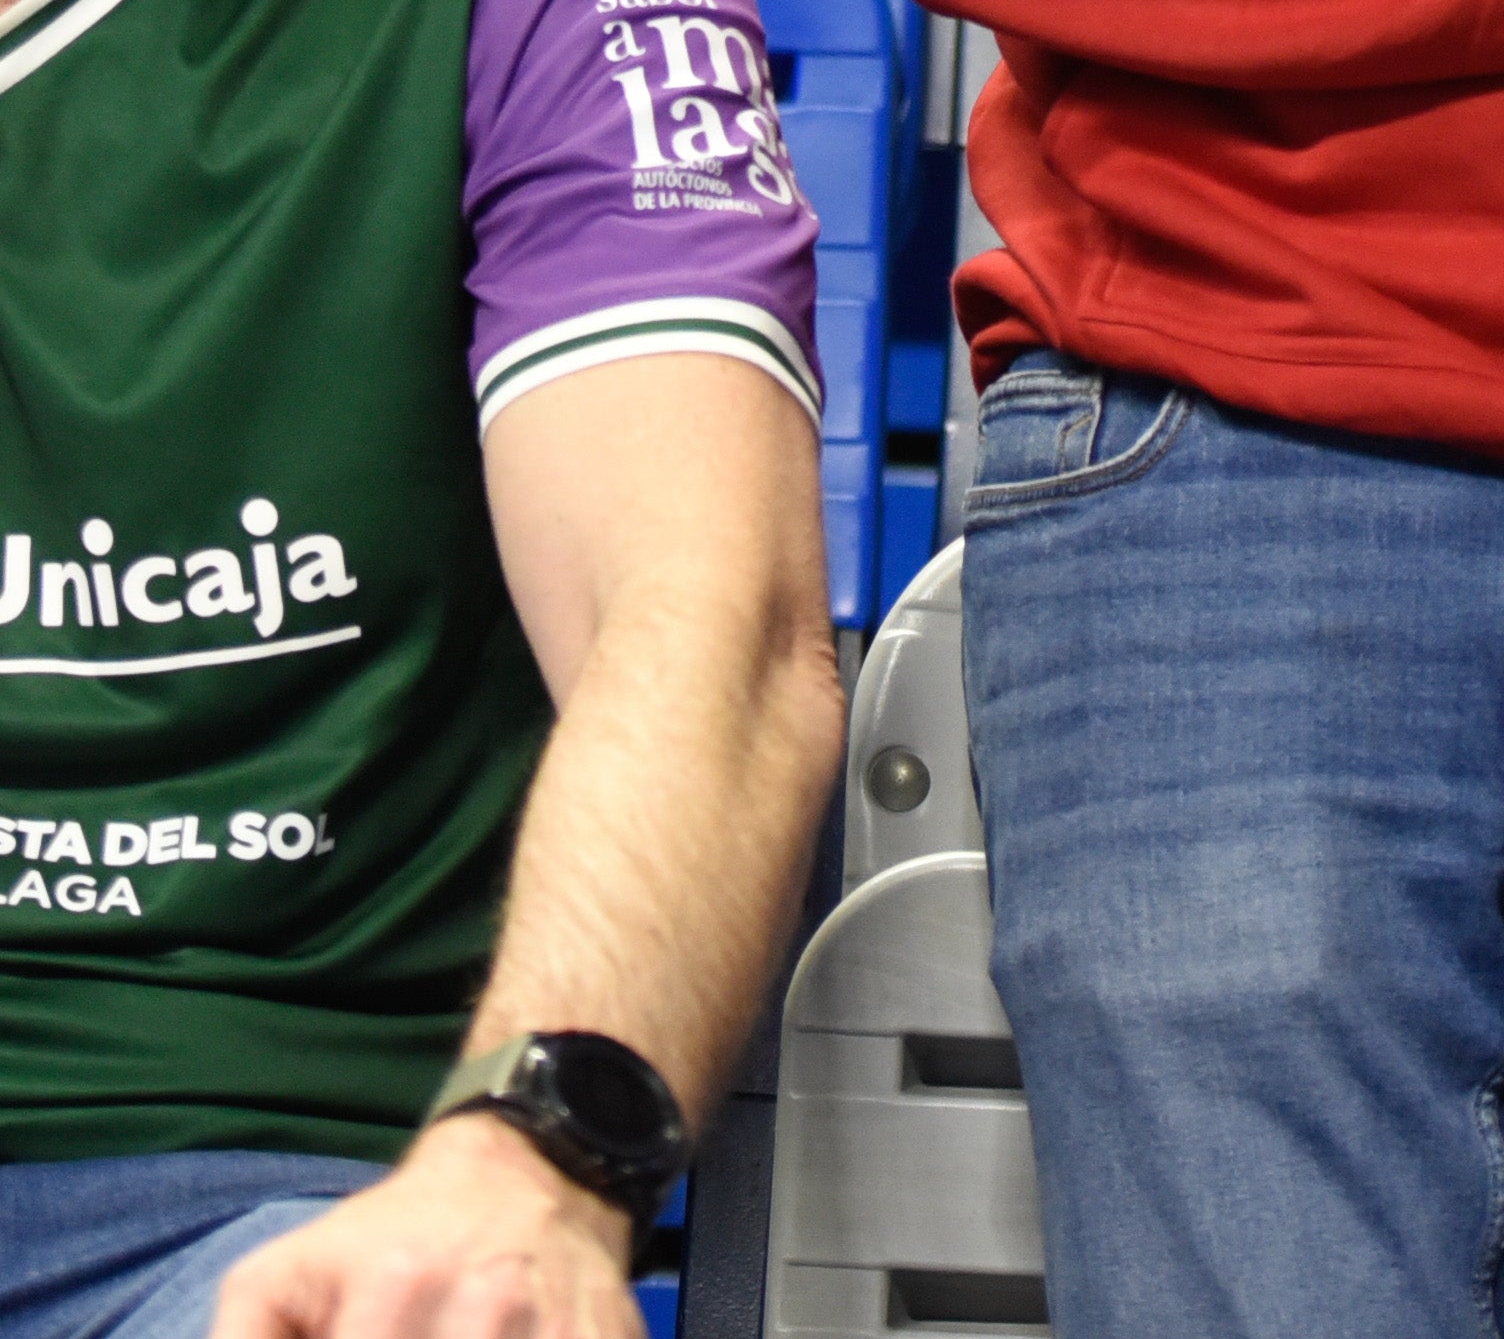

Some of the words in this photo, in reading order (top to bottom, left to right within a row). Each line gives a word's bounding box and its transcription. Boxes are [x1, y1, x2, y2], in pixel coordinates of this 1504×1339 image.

[603, 20, 646, 62] a
[633, 191, 656, 211] DE
[659, 191, 681, 209] LA
[102, 815, 217, 866] DEL
[226, 811, 335, 861] SOL
